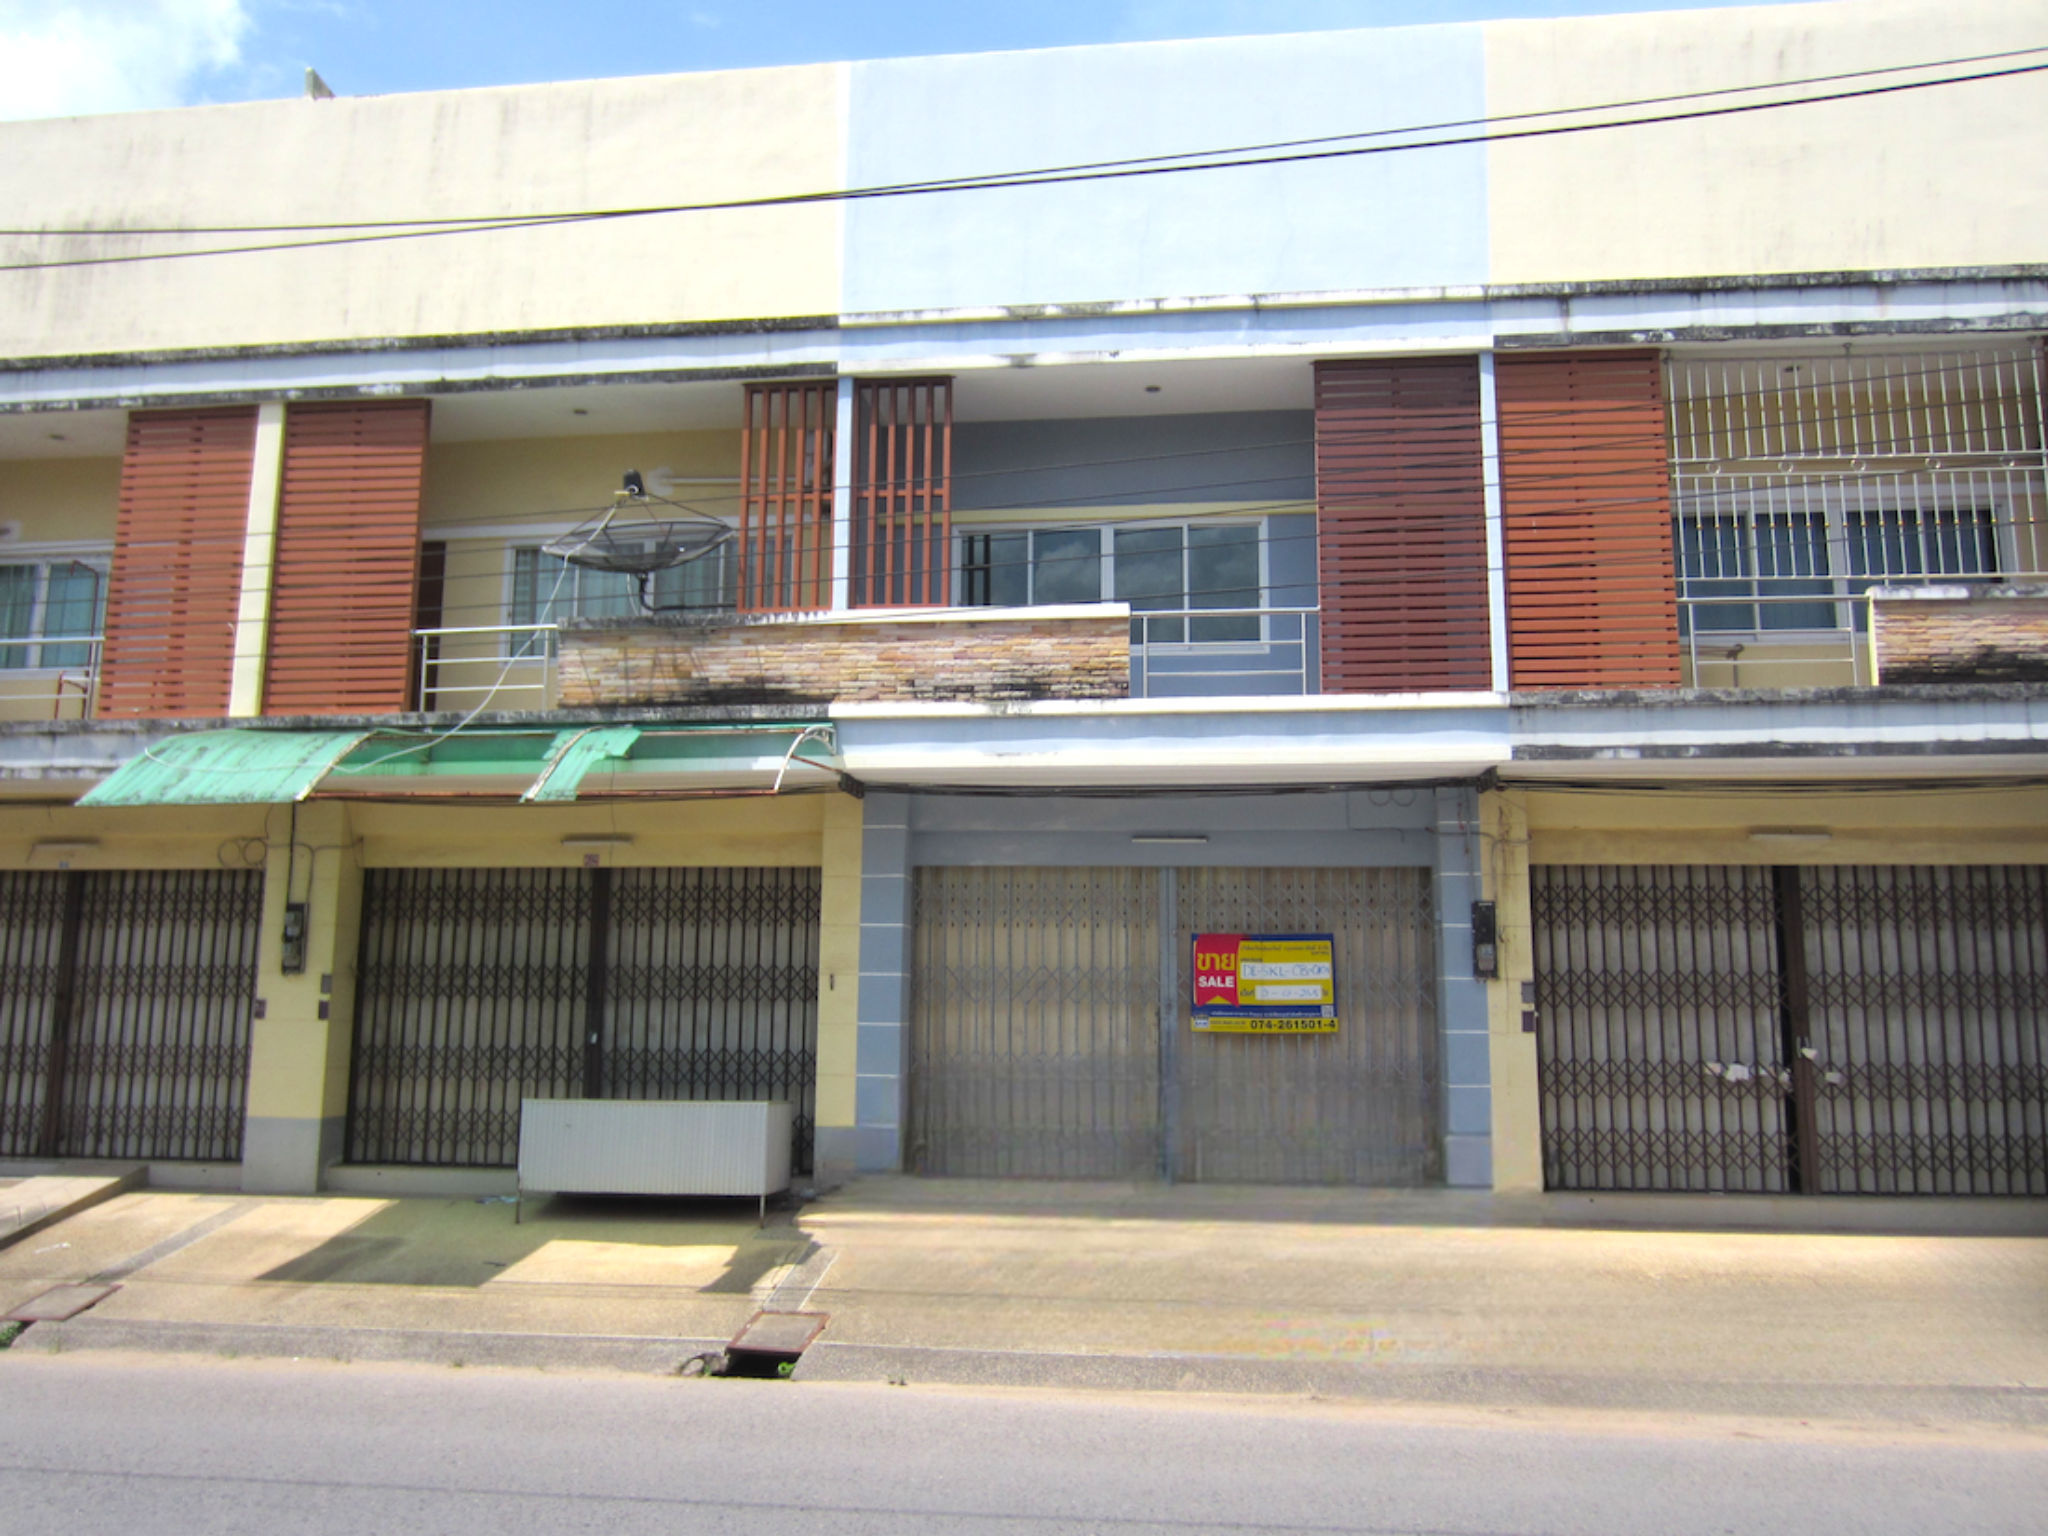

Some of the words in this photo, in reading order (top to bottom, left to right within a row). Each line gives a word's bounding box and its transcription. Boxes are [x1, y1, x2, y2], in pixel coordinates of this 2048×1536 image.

[1197, 953, 1235, 971] ขาย
[1198, 976, 1235, 988] SALE
[1250, 1019, 1336, 1030] 074-261501-4
